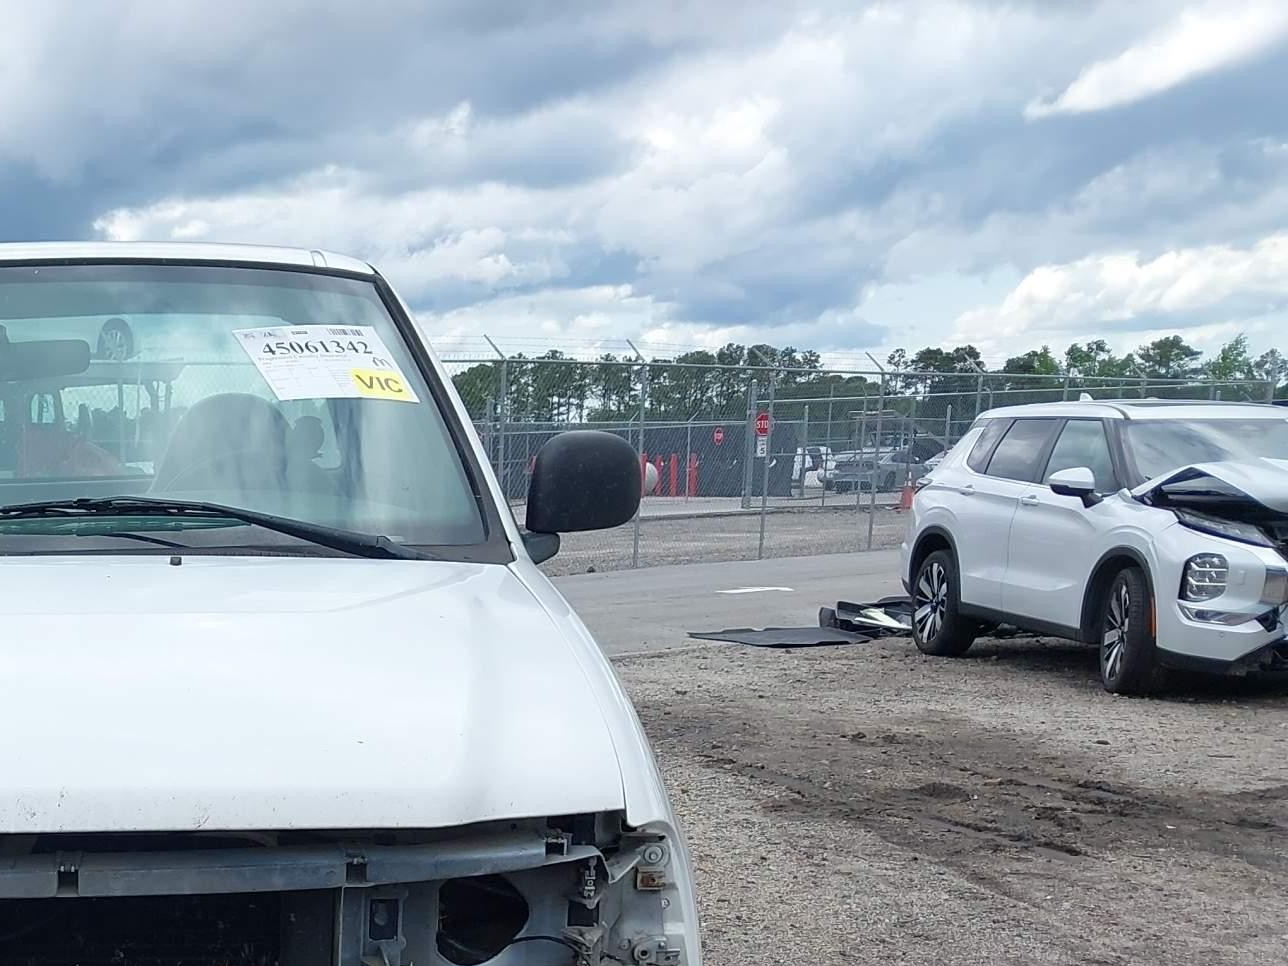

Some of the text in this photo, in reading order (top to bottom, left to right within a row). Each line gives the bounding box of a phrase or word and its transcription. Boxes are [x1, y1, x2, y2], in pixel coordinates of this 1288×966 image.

[262, 340, 373, 355] 45061342
[355, 374, 404, 393] VIC
[756, 420, 770, 429] STO
